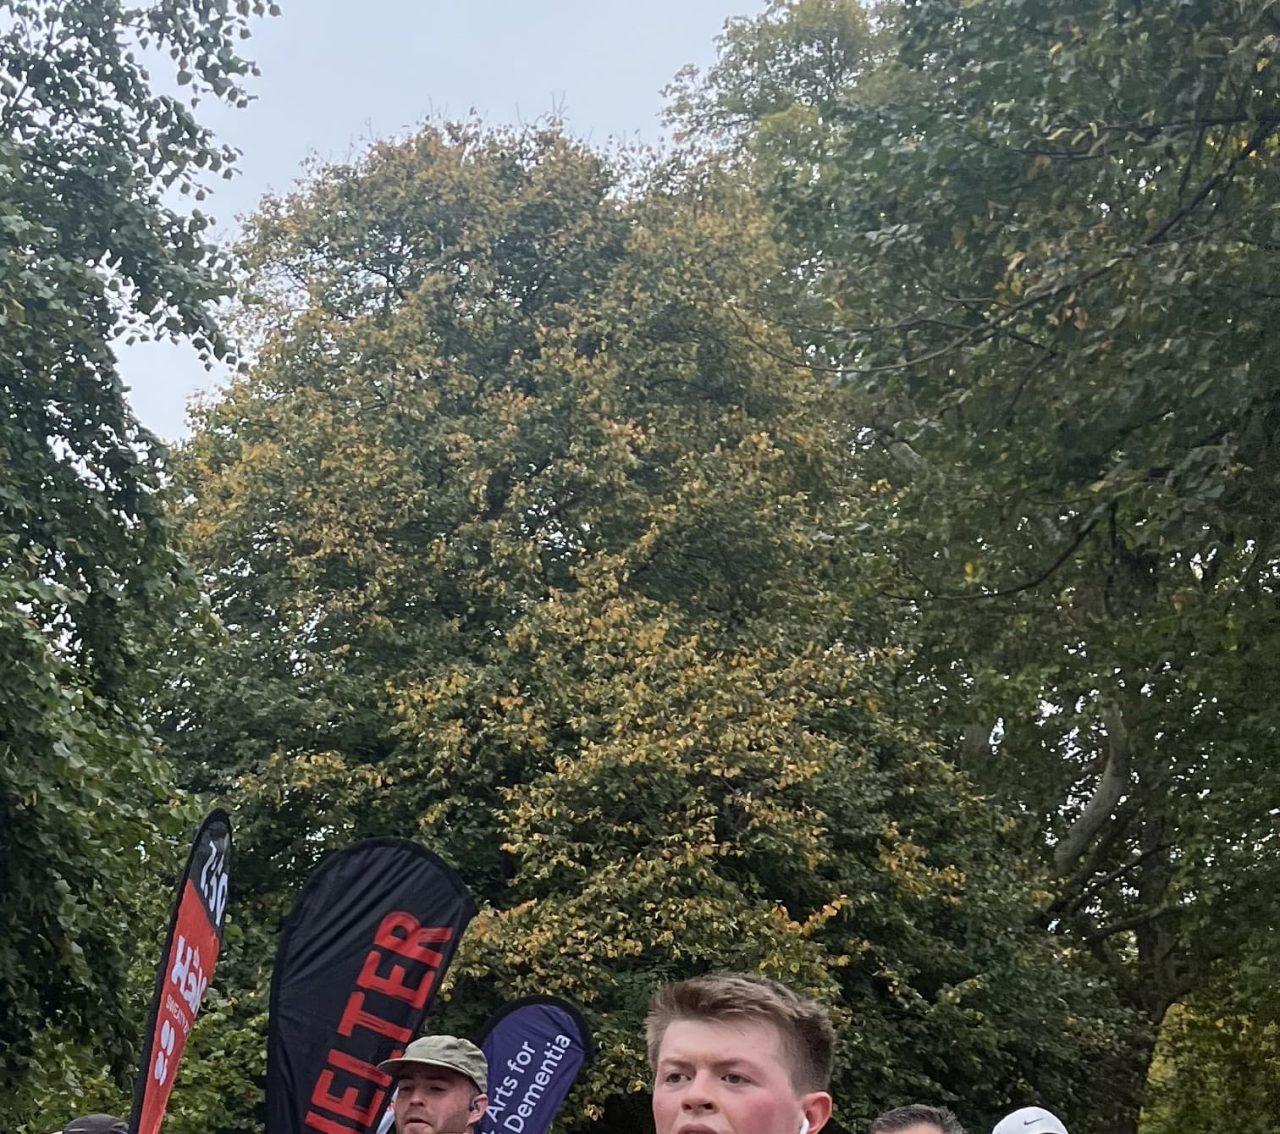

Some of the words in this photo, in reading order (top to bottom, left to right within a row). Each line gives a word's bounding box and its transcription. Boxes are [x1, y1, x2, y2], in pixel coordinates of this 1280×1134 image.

[485, 1076, 518, 1123] Arts
[506, 1040, 537, 1077] for
[504, 1033, 573, 1134] Dementia
